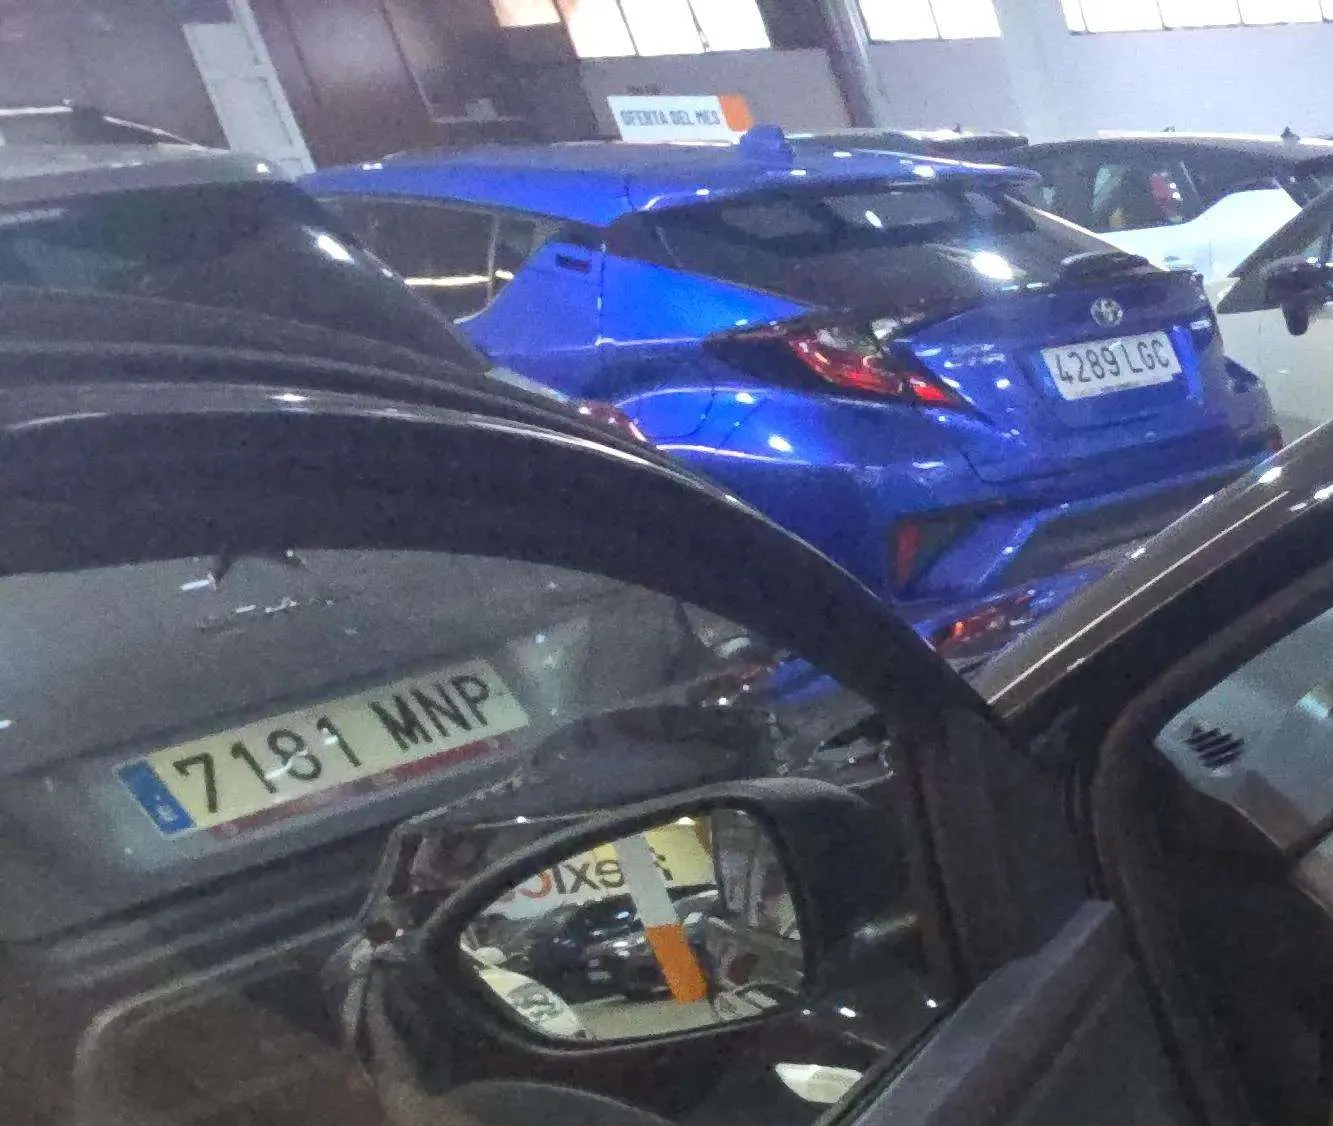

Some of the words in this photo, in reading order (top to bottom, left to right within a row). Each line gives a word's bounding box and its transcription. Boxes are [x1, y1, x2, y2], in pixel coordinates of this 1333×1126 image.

[620, 110, 668, 126] OFERTA
[669, 109, 694, 126] DEL
[1055, 347, 1121, 384] 4289
[1121, 338, 1170, 374] LGC
[172, 714, 361, 814] 7181
[369, 674, 491, 752] MNP
